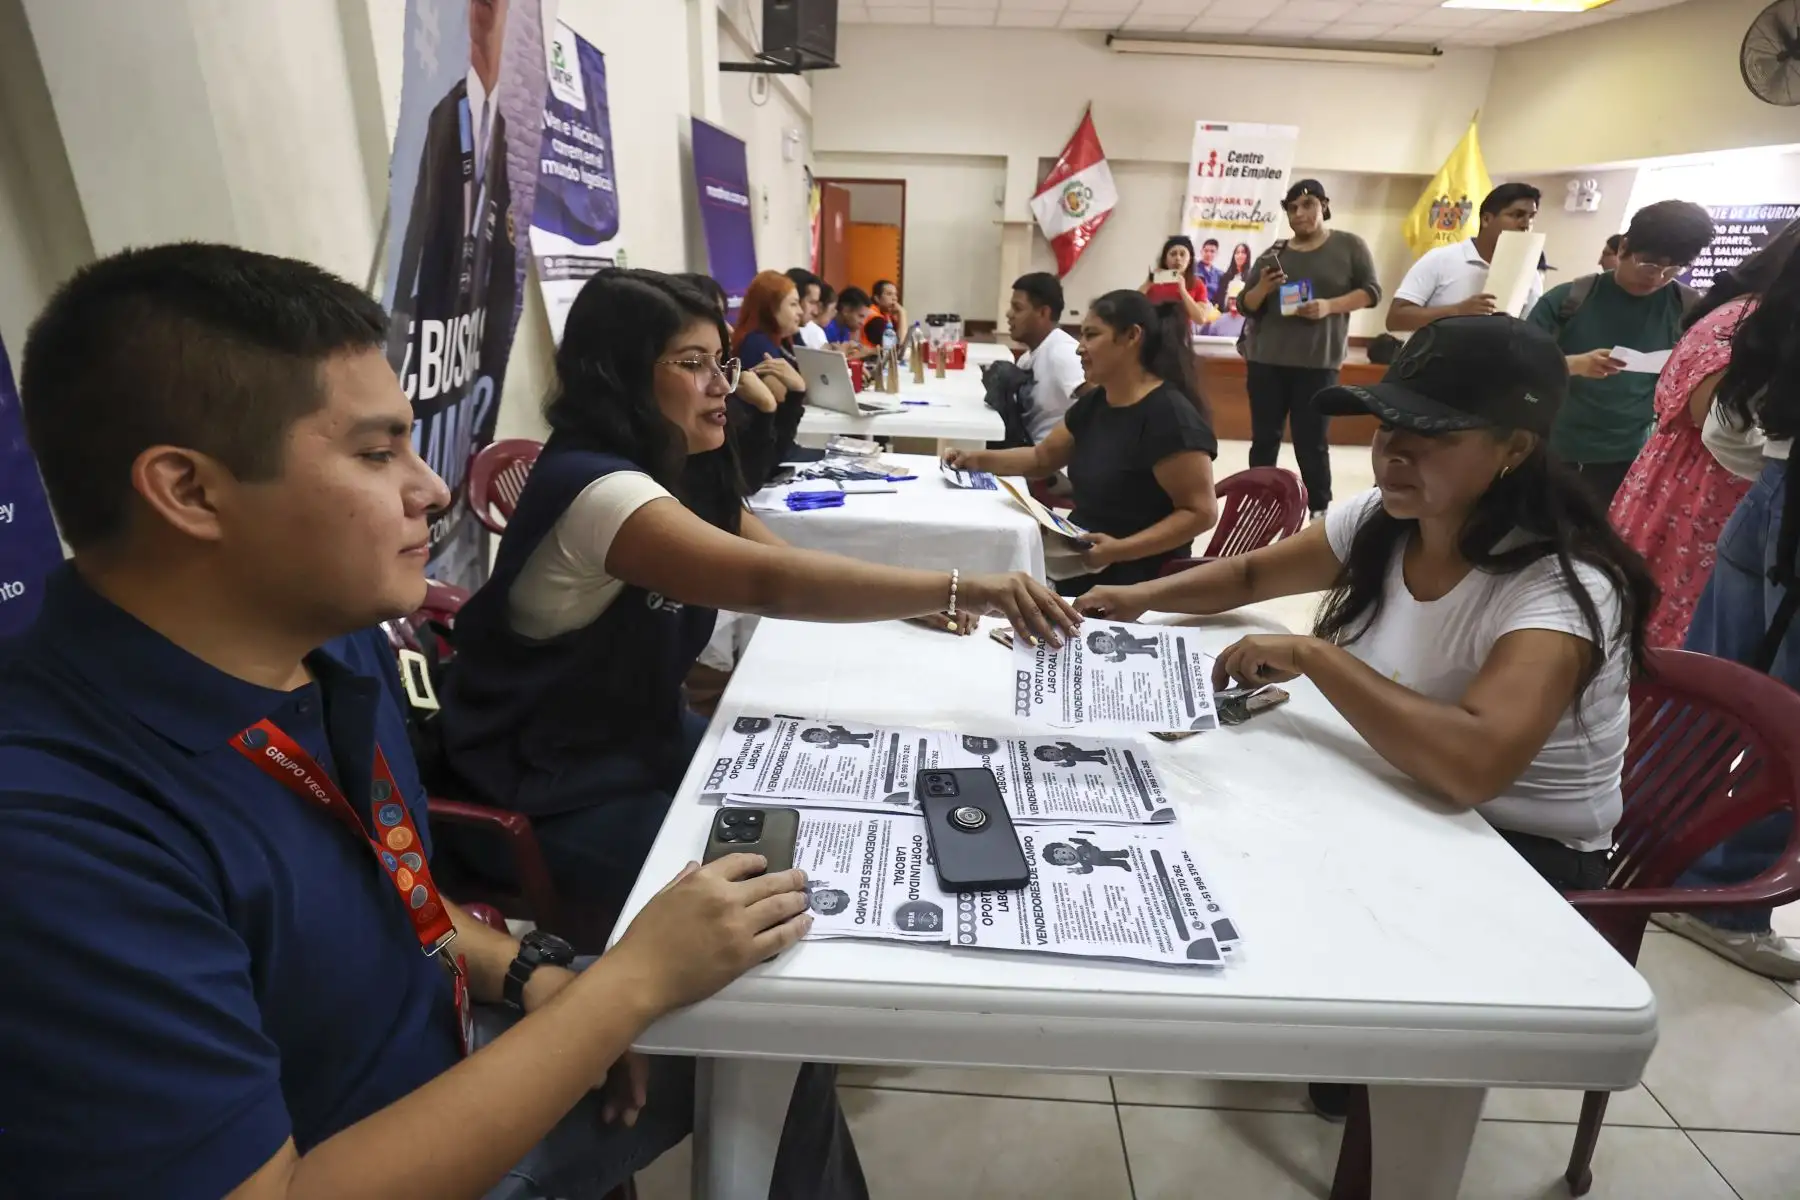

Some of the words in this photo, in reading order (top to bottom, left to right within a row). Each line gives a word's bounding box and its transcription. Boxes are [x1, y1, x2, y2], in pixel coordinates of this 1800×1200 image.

[1227, 150, 1264, 164] Centro
[1226, 166, 1240, 178] de
[1242, 166, 1282, 180] Empleo
[1729, 206, 1747, 220] DE
[1728, 225, 1742, 234] DE
[1692, 268, 1728, 277] CALL
[1074, 653, 1082, 664] DE
[1191, 652, 1199, 663] 262
[1034, 636, 1046, 704] OPORTUNIDAD
[1048, 652, 1058, 694] LABORAL
[1193, 666, 1202, 676] 370
[1195, 678, 1204, 689] 998
[1074, 664, 1084, 723] VENDEDORES
[729, 733, 756, 780] OPORTUNIDAD
[746, 742, 765, 770] LABORAL
[766, 750, 792, 792] VENDEDORES
[784, 722, 799, 741] CAMPO
[1020, 740, 1031, 762] CAMPO
[1024, 763, 1033, 771] DE
[1144, 769, 1154, 777] 370
[266, 746, 306, 776] GRUPO
[304, 776, 331, 804] VEGA
[996, 764, 1008, 794] LABORAL
[1148, 778, 1158, 787] 998
[1026, 771, 1040, 815] VENDEDORES
[861, 819, 878, 876] VENDEDORES
[1023, 835, 1036, 866] CAMPO
[893, 846, 908, 886] LABORAL
[908, 834, 922, 900] OPORTUNIDAD
[1028, 867, 1038, 879] DE
[1172, 864, 1184, 878] 262
[1187, 864, 1199, 876] 370
[860, 876, 870, 888] DE
[1178, 878, 1189, 892] 370
[1194, 876, 1206, 890] 998
[1183, 893, 1194, 906] 998
[1202, 892, 1212, 902] +51
[854, 890, 869, 925] CAMPO
[1031, 880, 1048, 945] VENDEDORES
[1188, 908, 1198, 920] +51
